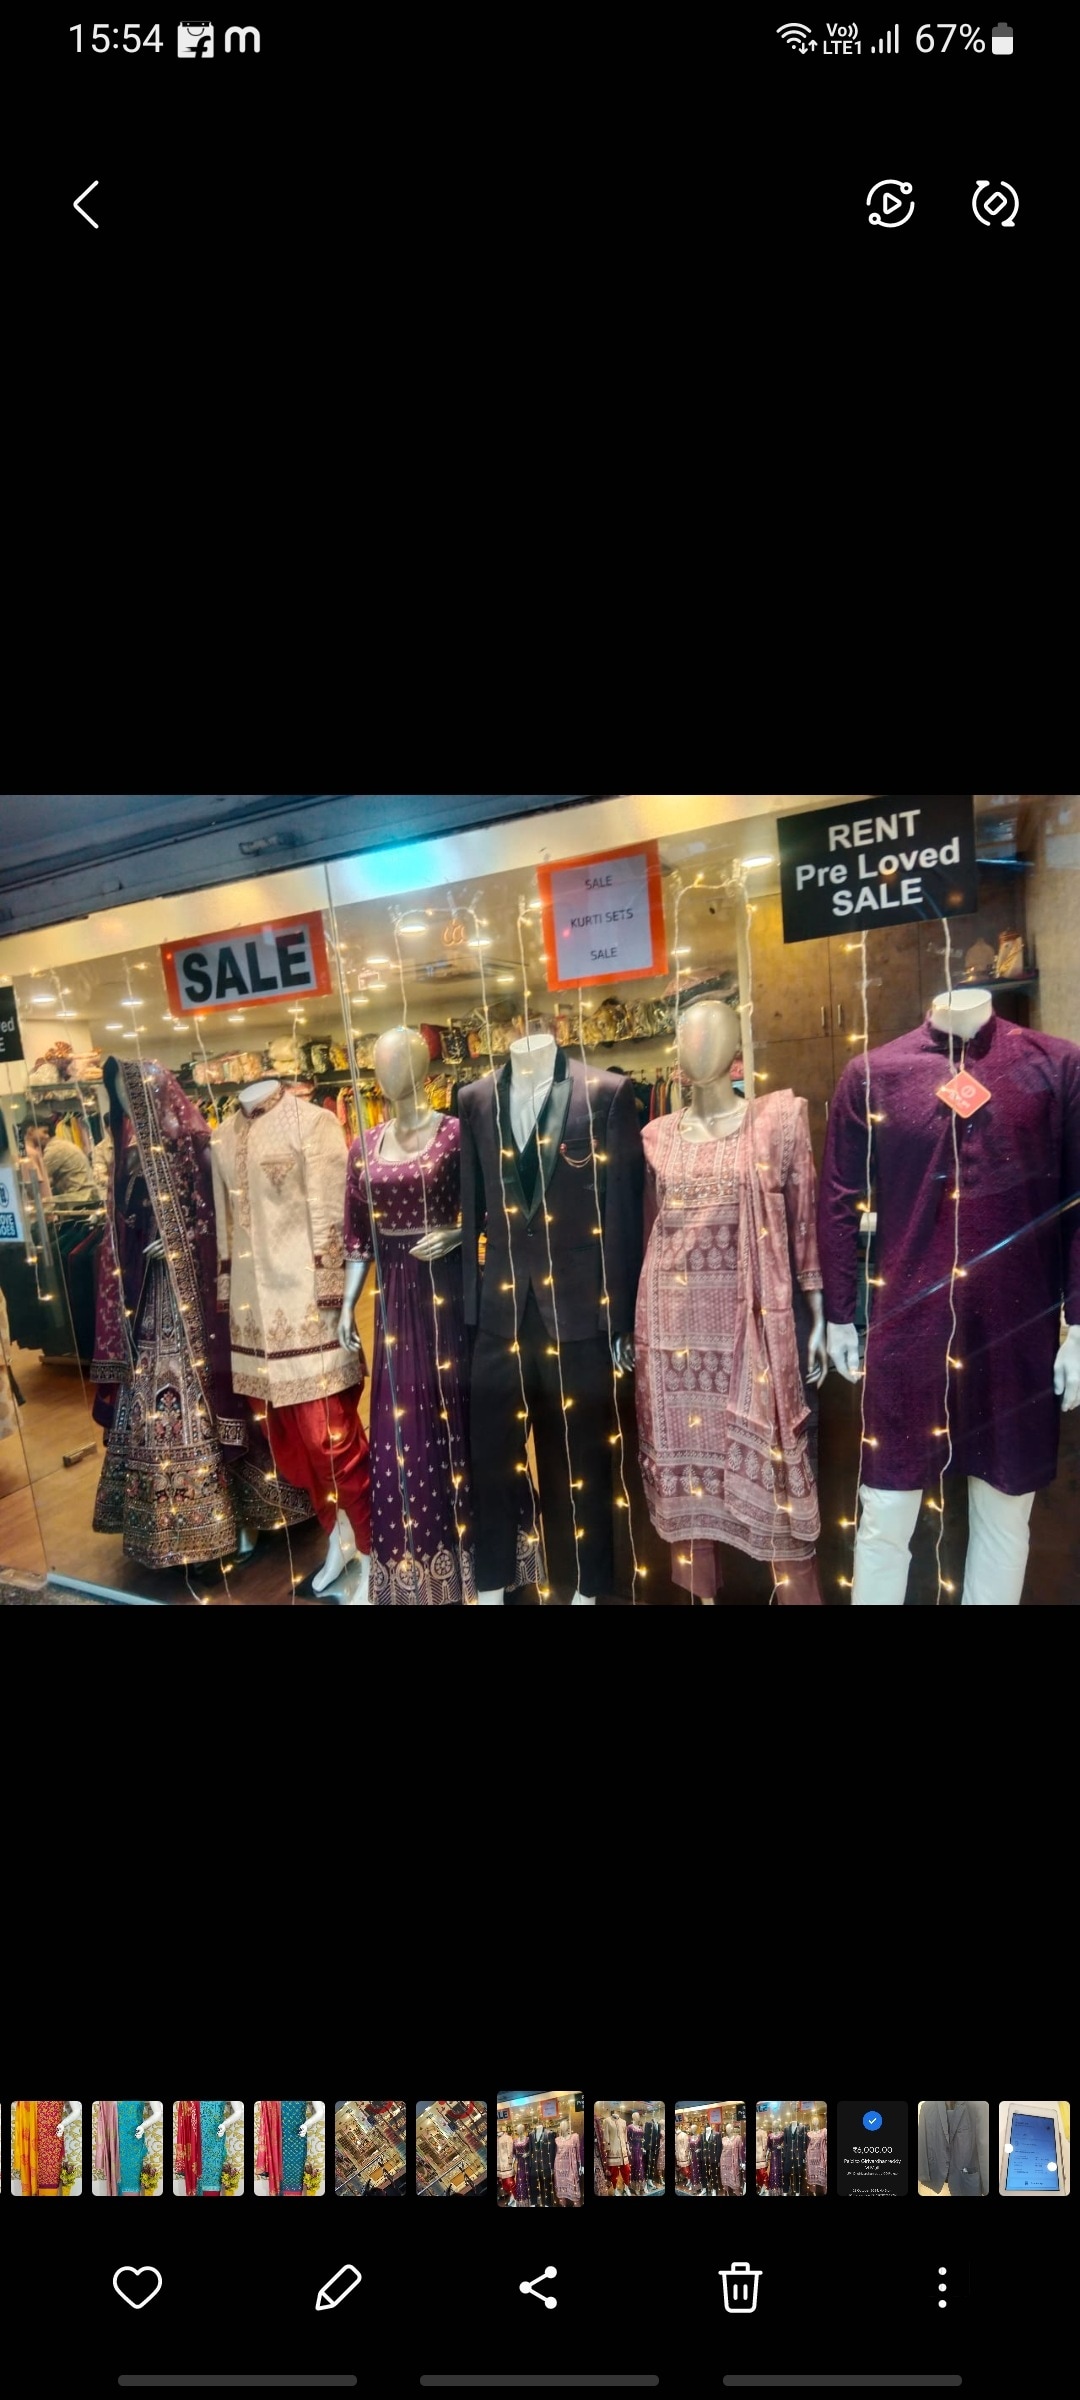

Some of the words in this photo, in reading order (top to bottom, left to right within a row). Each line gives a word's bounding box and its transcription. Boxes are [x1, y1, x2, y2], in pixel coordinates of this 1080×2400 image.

[69, 23, 163, 53] 15:54
[822, 40, 862, 55] LTE1
[915, 23, 986, 53] 67%
[828, 809, 921, 852] RENT
[795, 863, 848, 891] Pre
[857, 836, 960, 880] Loved
[584, 875, 613, 890] SALE
[832, 877, 924, 917] SALE
[570, 913, 603, 928] KURTI
[605, 908, 634, 923] SETS
[182, 932, 312, 1004] SALE
[590, 947, 618, 961] SALE
